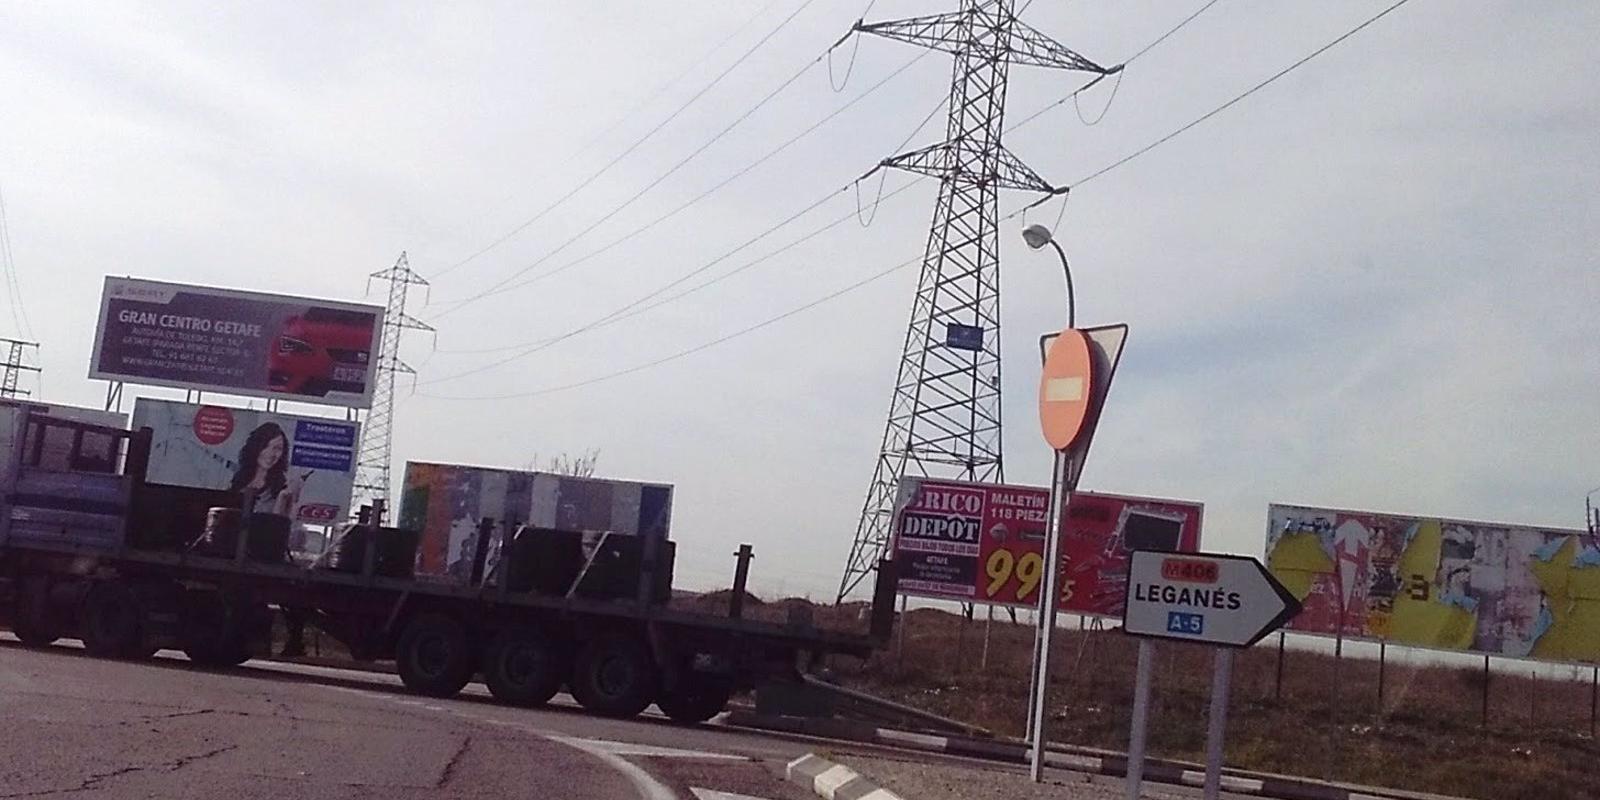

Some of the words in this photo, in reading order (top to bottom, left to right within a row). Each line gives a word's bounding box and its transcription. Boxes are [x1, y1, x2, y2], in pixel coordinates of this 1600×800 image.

[119, 310, 157, 325] GRAN
[160, 314, 211, 331] CENTRO
[214, 320, 262, 337] GETAFE
[992, 493, 1045, 508] MALETÍN
[991, 508, 1011, 520] 118
[986, 549, 1043, 600] 99
[1135, 583, 1241, 610] LEGANÉS
[1169, 615, 1200, 630] A-5
